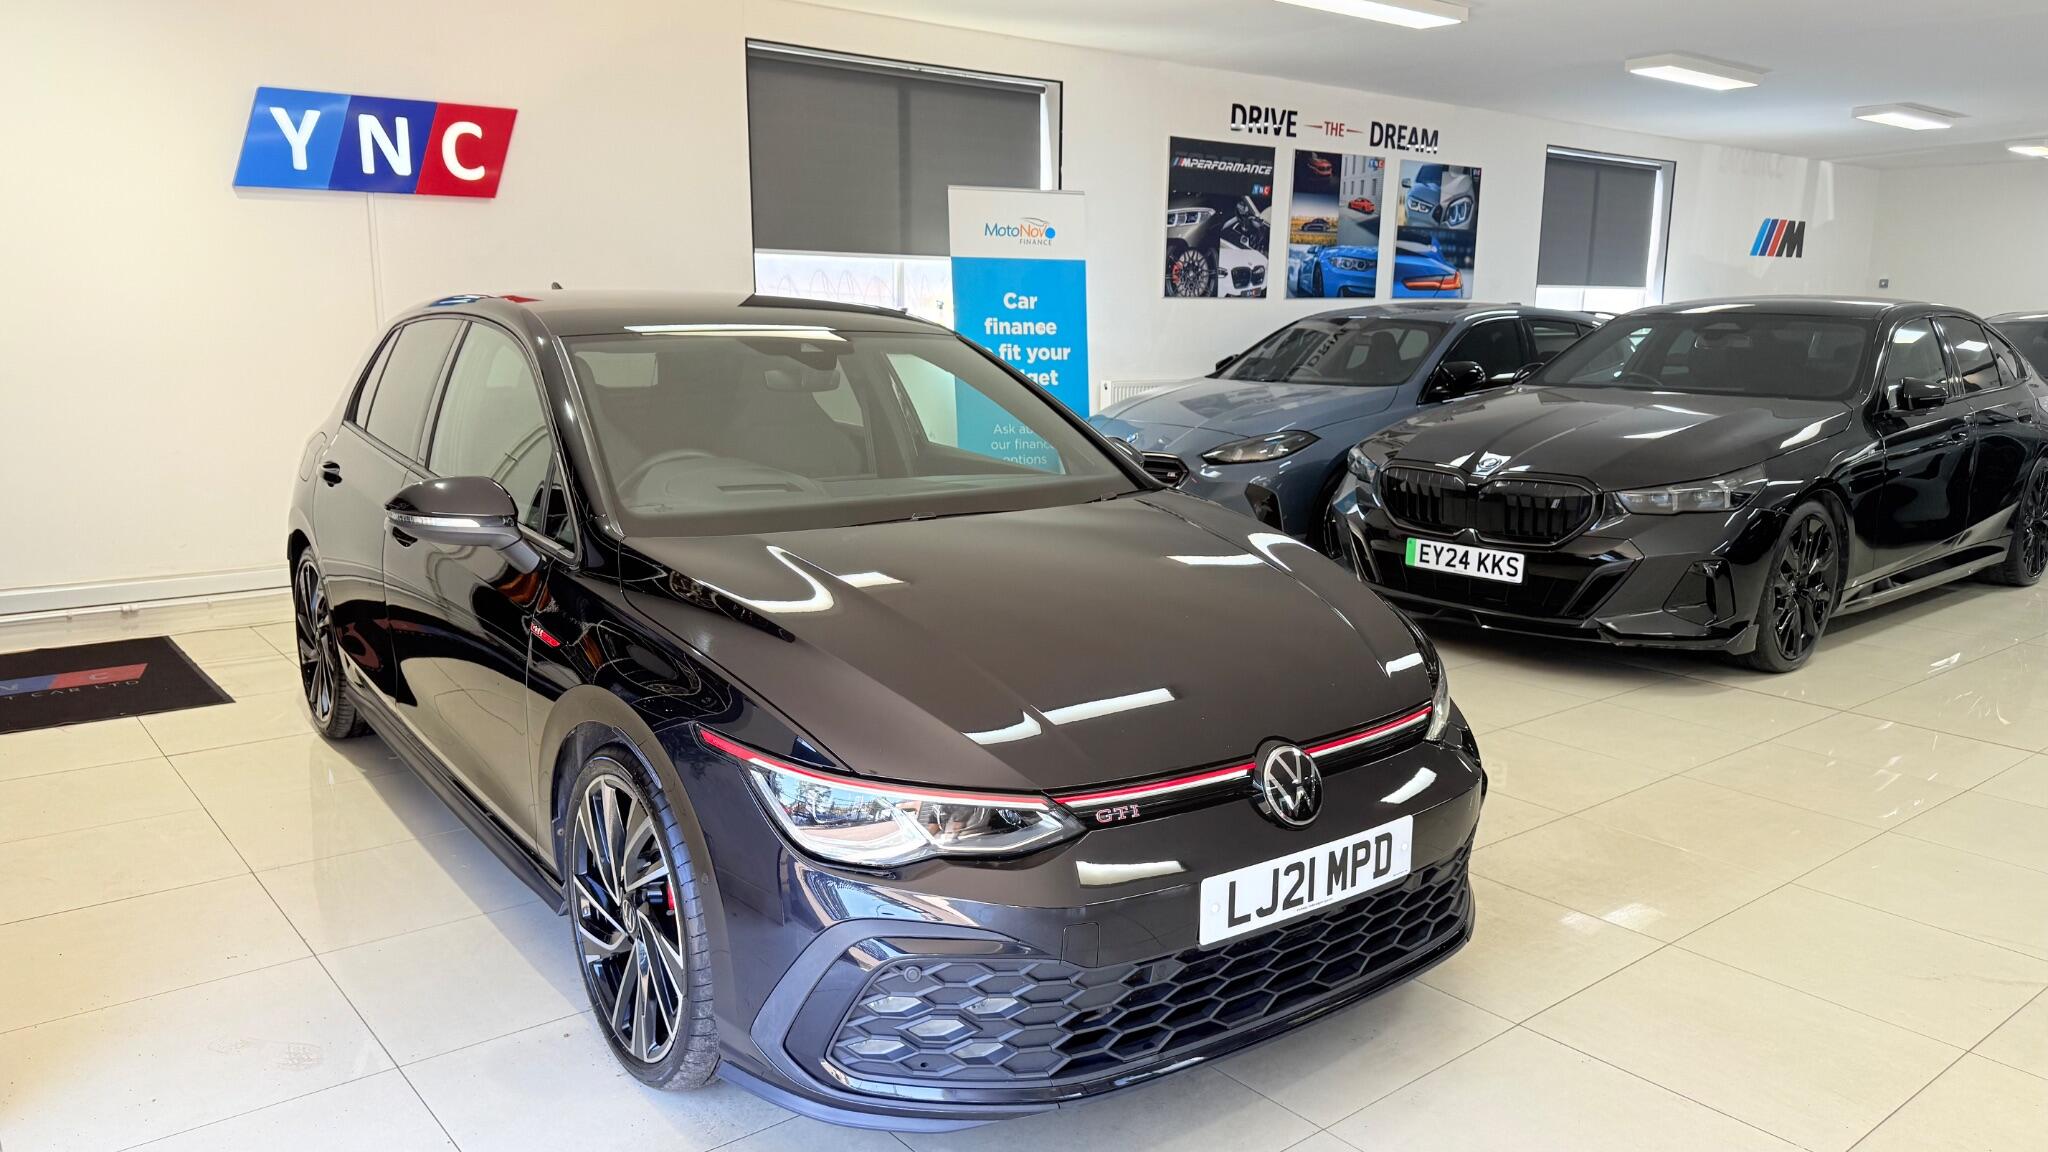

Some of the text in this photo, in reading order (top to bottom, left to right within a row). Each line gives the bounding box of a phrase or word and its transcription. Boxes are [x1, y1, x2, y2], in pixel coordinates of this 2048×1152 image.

[1231, 103, 1439, 154] DRIVE THE DREAM
[269, 106, 486, 181] YNC
[1019, 238, 1052, 246] FINANCE
[1003, 292, 1037, 309] Car
[984, 317, 1057, 336] finance
[999, 343, 1071, 364] fit your
[993, 424, 1016, 434] Ask
[991, 439, 1055, 450] our financ
[1419, 543, 1519, 577] EY24 KKS
[0, 672, 109, 692] NC
[1095, 804, 1141, 823] GTI
[1228, 832, 1393, 928] LJ21 MPD
